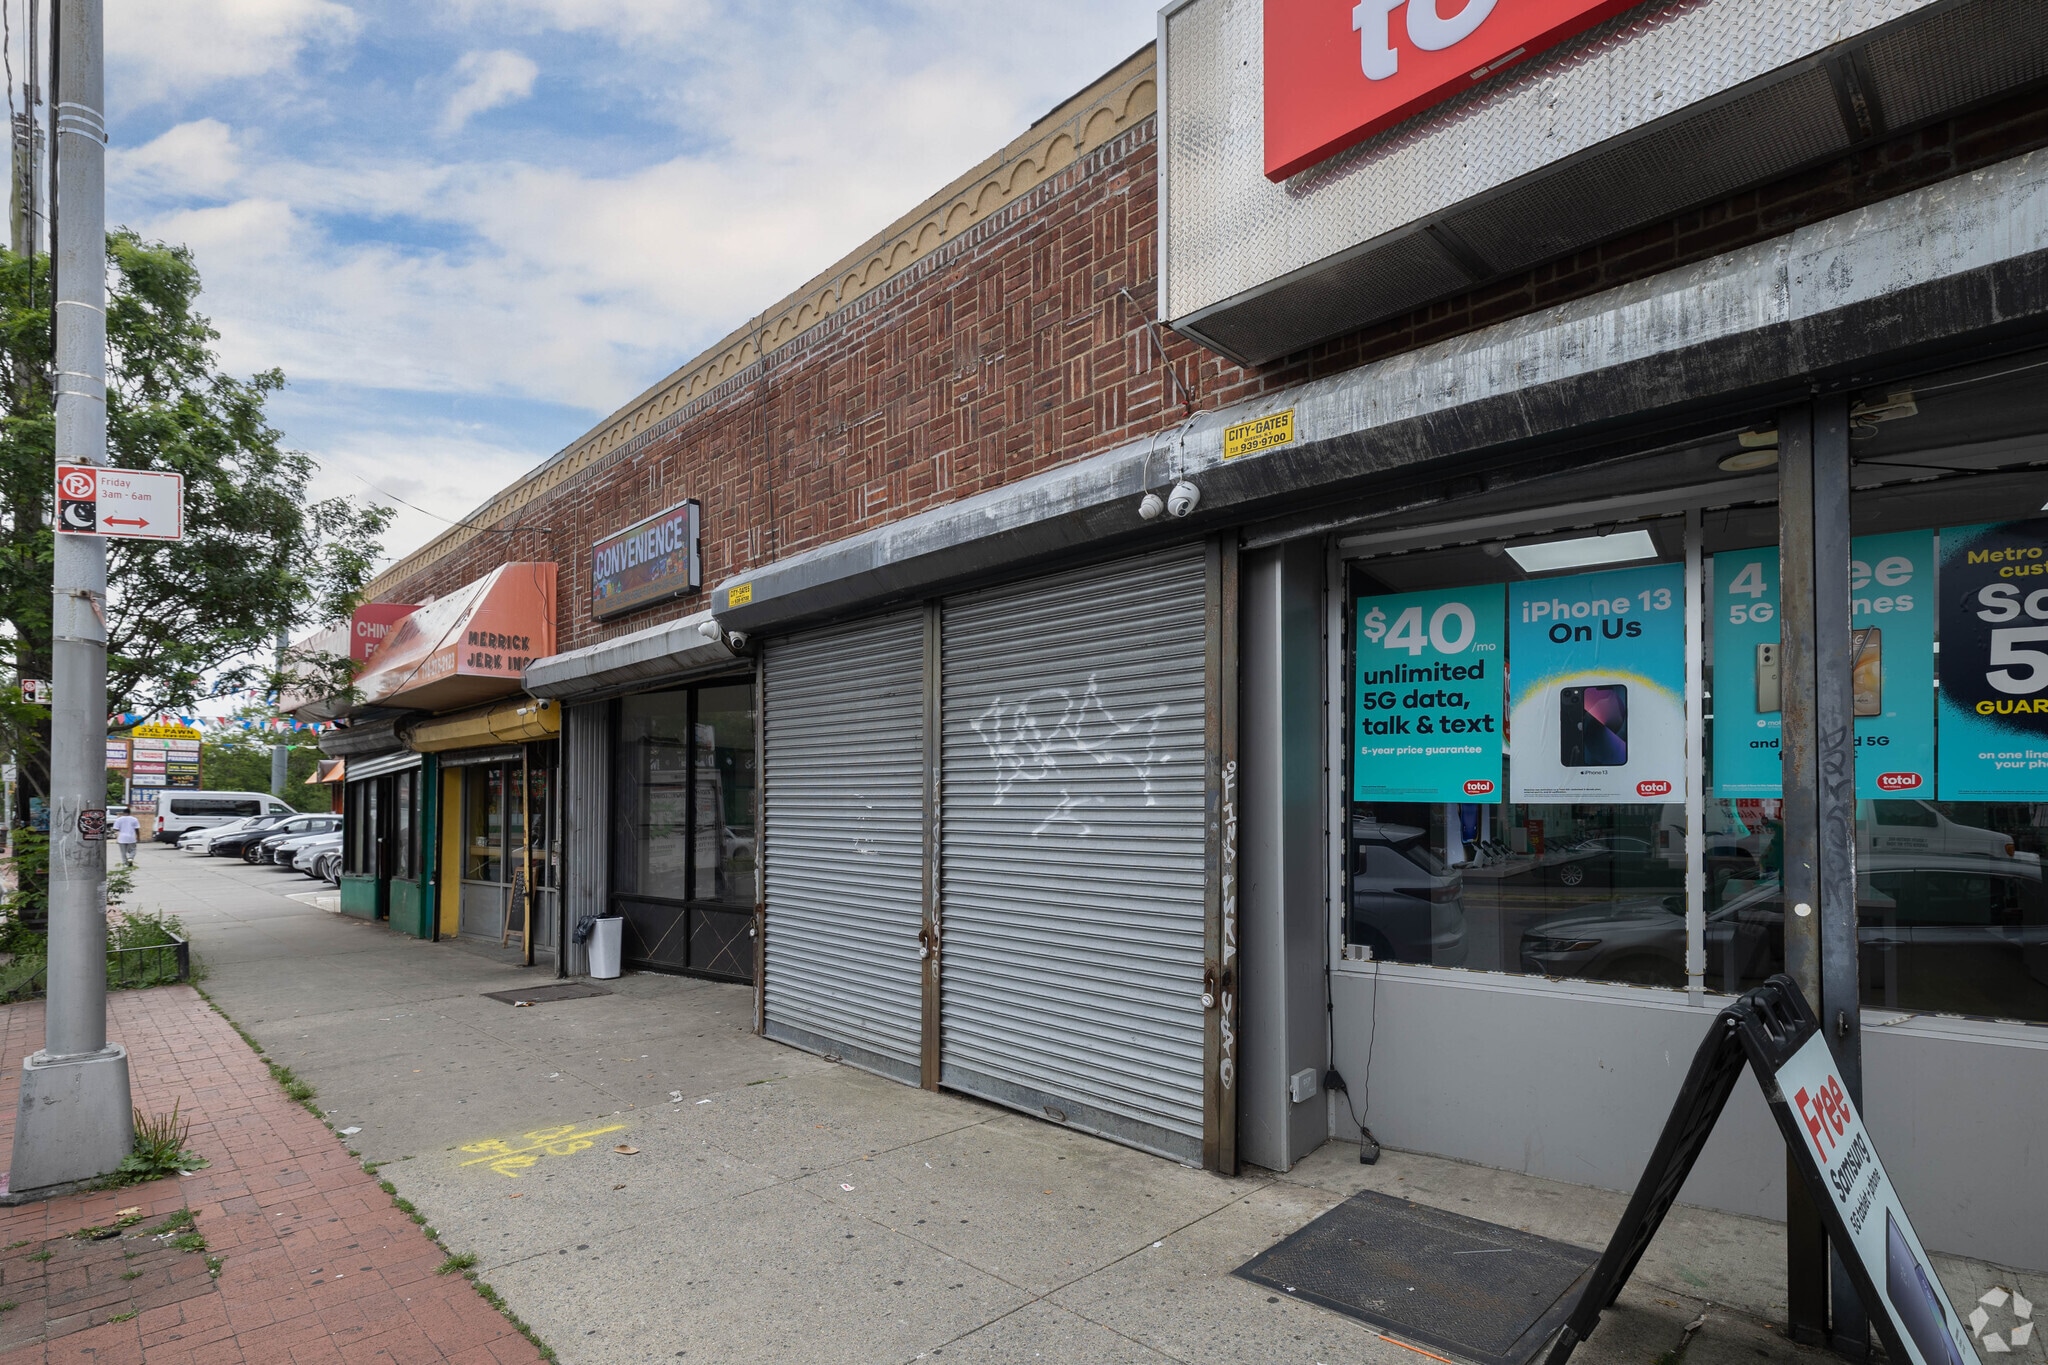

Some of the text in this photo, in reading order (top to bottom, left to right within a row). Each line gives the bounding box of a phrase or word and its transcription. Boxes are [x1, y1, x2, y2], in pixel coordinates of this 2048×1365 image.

[1228, 415, 1289, 442] CITY-GATES
[1240, 432, 1287, 452] 939-9700
[101, 477, 131, 489] Friday
[102, 489, 123, 500] 3am
[131, 491, 152, 501] 6am
[595, 515, 684, 581] CONVENIENCE
[1968, 547, 2042, 565] Metro
[1728, 555, 1914, 599] 4 ee
[1522, 588, 1672, 624] iPhone 13
[1729, 602, 1774, 625] 5G
[356, 621, 392, 639] CHIN
[1548, 618, 1642, 644] On Us
[468, 631, 531, 652] MERRICK
[467, 652, 503, 670] JERK
[1363, 660, 1485, 685] unlimited
[1362, 688, 1471, 713] 5G data,
[1362, 714, 1495, 736] talk & text
[1361, 744, 1483, 757] 5-year price guarantee
[1749, 735, 1779, 748] and
[1866, 735, 1890, 747] 5G
[1997, 751, 2023, 759] one
[1994, 761, 2026, 770] your
[1467, 781, 1490, 791] total
[1640, 782, 1667, 792] total
[1882, 774, 1916, 785] total
[1793, 1073, 1852, 1165] Free
[1829, 1131, 1872, 1203] Samsung
[1850, 1213, 1862, 1236] 5G
[1858, 1193, 1872, 1224] tablet
[1870, 1168, 1883, 1200] phone
